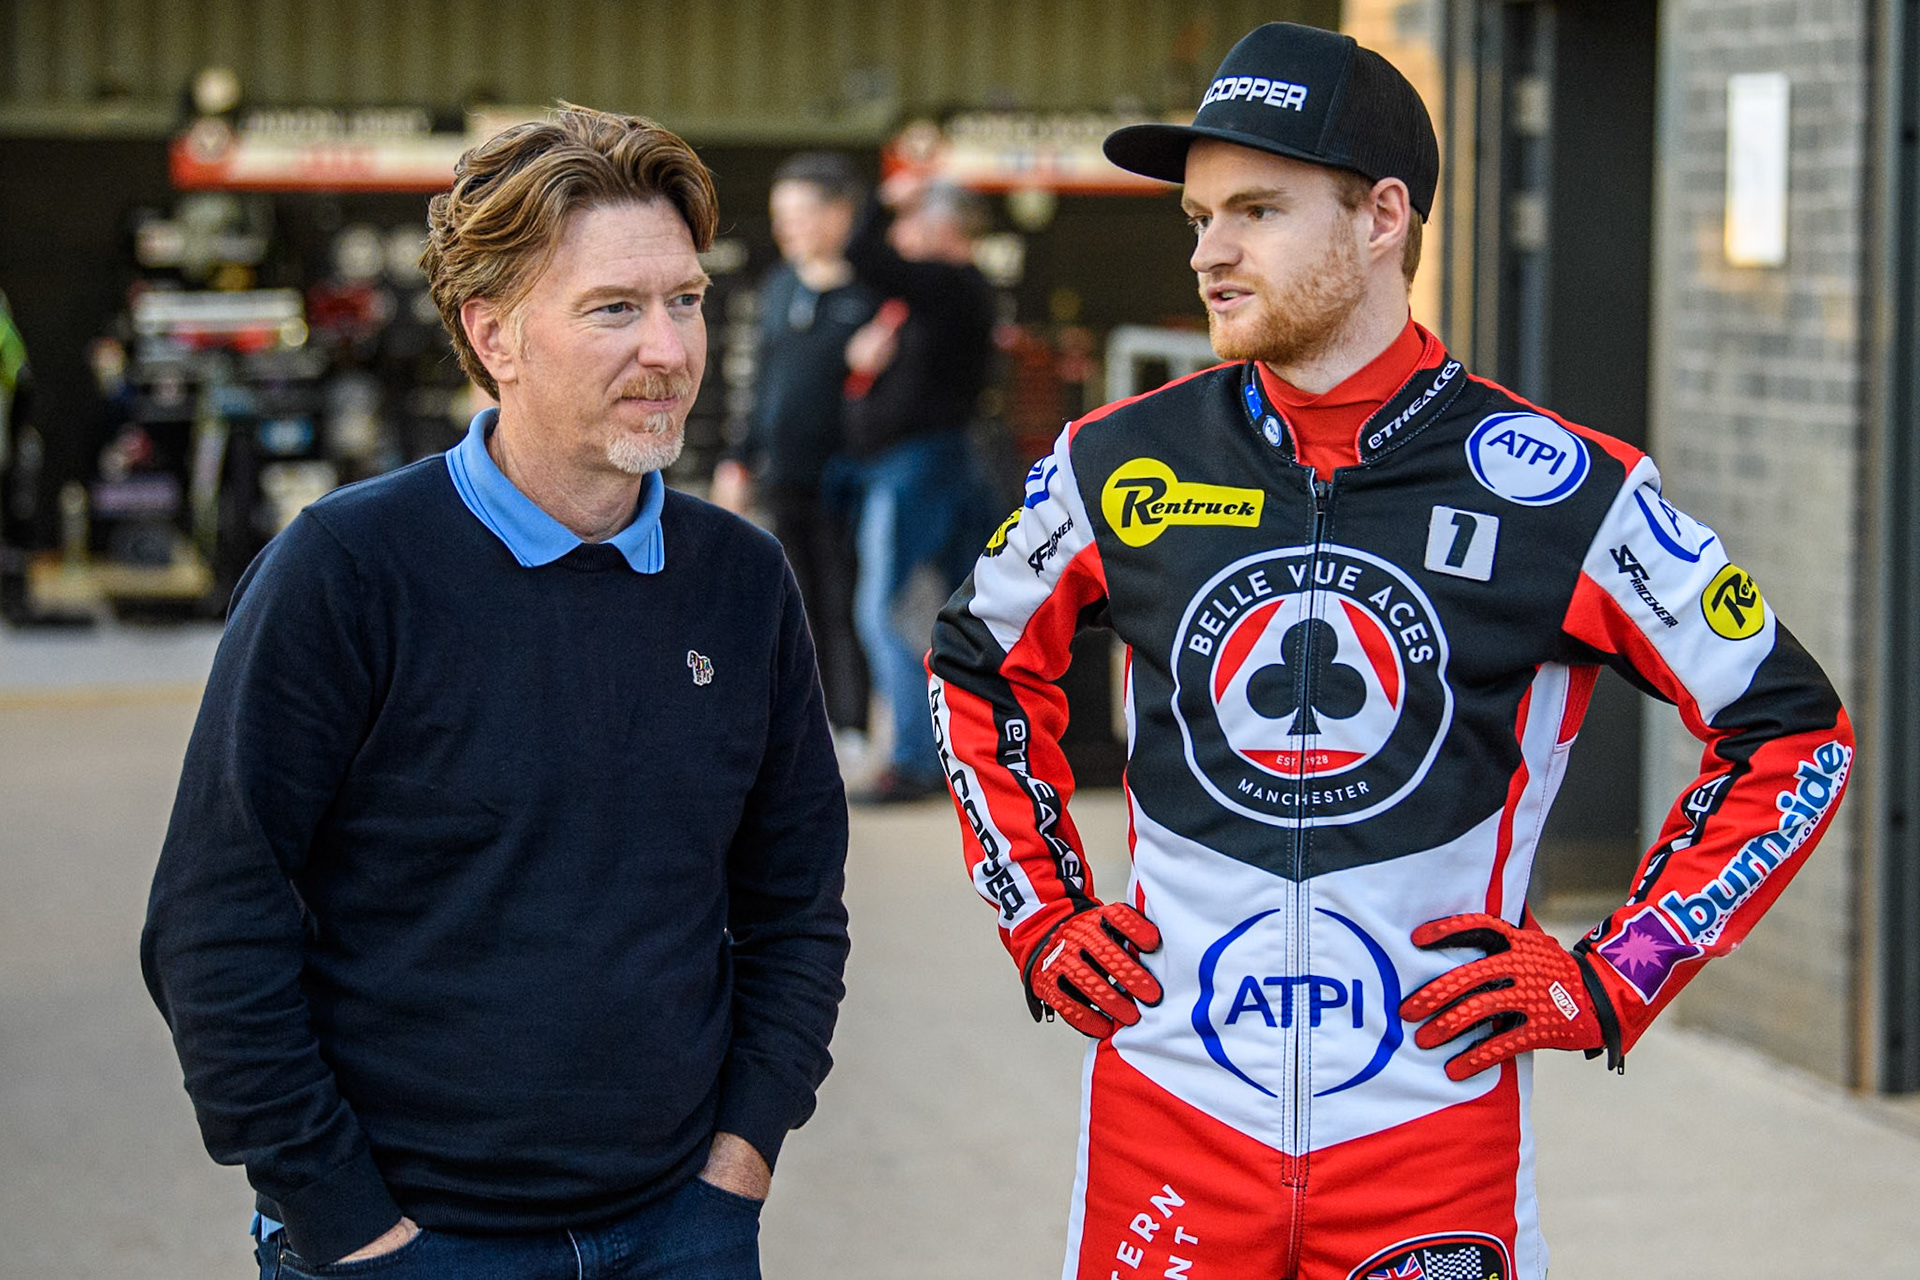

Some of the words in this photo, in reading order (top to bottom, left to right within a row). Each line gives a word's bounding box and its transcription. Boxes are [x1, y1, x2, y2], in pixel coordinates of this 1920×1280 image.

[1368, 360, 1461, 450] @THEACES
[1486, 429, 1567, 476] ATPI
[1113, 477, 1256, 529] Rentruck
[1444, 512, 1478, 569] 1
[1188, 569, 1273, 657] BELLE
[1287, 560, 1363, 591] VUE
[1368, 585, 1434, 664] ACES
[1237, 778, 1370, 806] MANCHESTER
[1663, 742, 1845, 940] burnside
[1223, 974, 1364, 1029] ATPI
